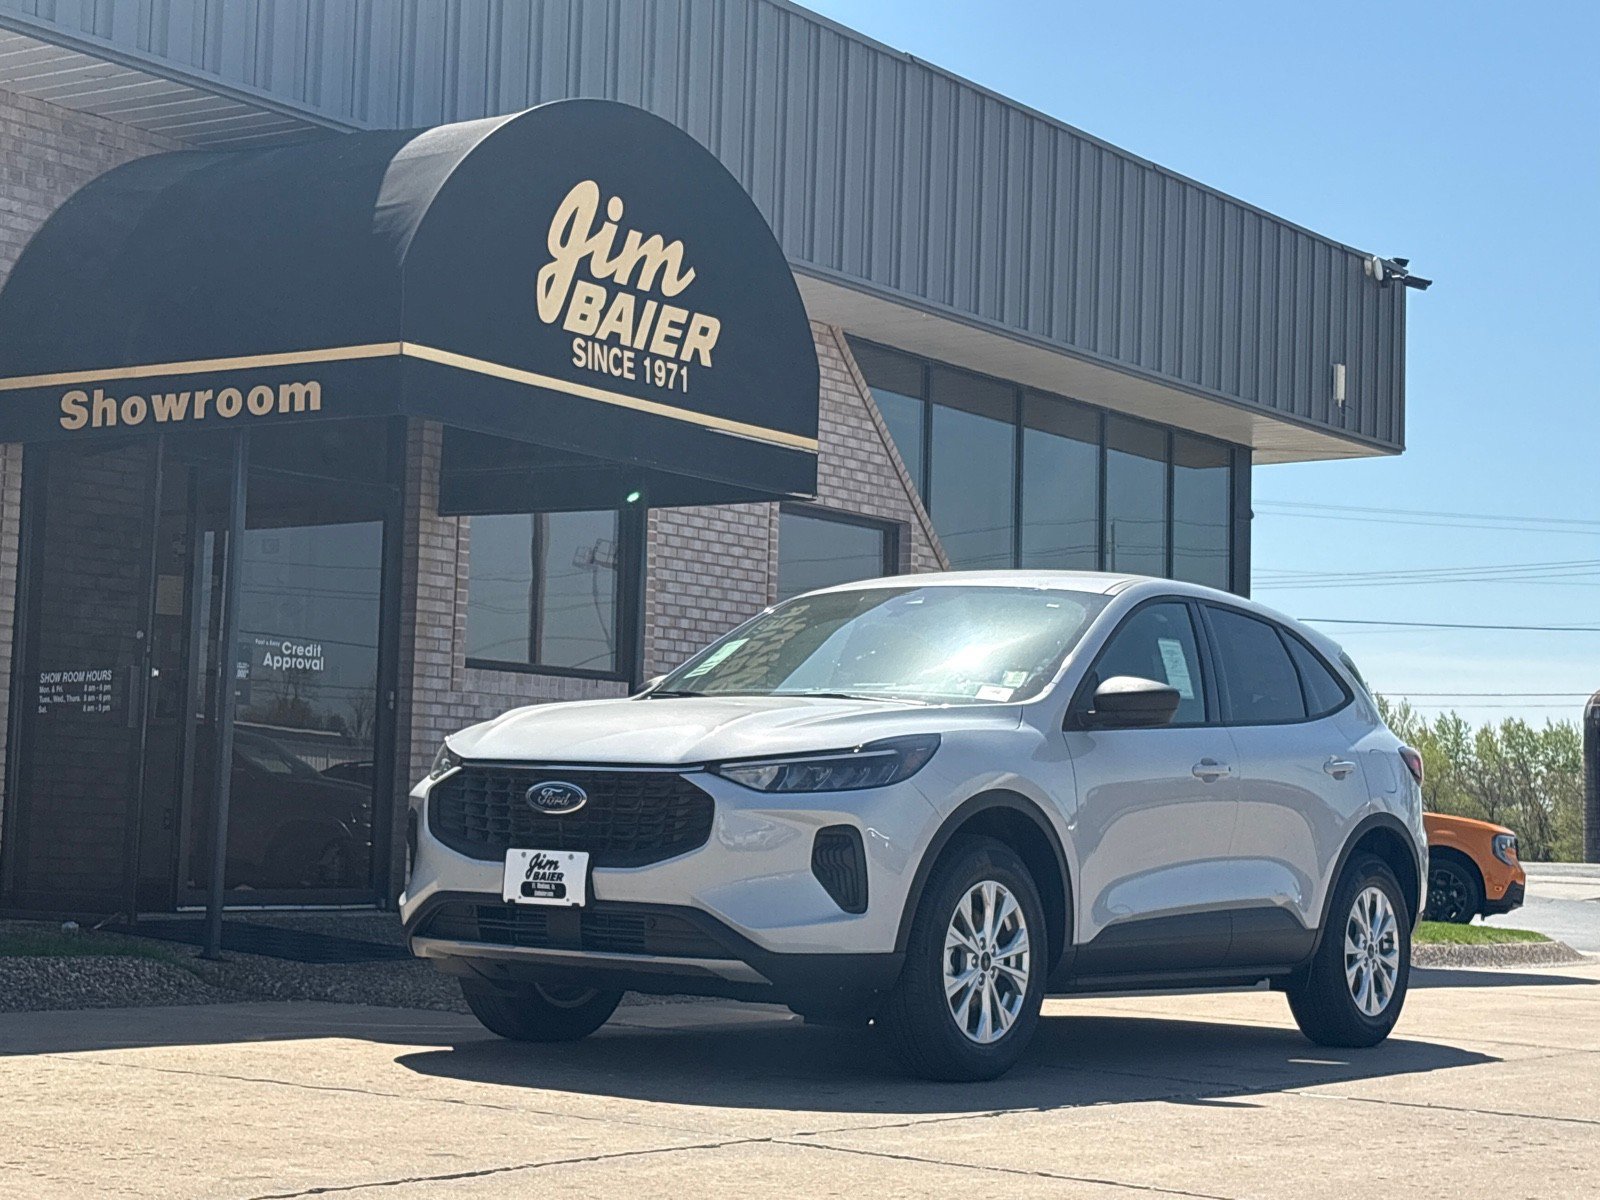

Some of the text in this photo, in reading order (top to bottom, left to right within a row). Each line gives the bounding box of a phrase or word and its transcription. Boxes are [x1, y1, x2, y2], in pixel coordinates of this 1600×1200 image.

[537, 180, 696, 323] Jim
[563, 280, 720, 367] BAIER
[572, 337, 688, 393] SINCE 1971
[60, 380, 321, 430] Showroom
[281, 641, 321, 657] Credit
[262, 652, 324, 671] Approval
[40, 669, 112, 683] SHOW ROOM HOURS
[538, 787, 571, 806] Ford
[525, 852, 560, 880] Jim
[532, 871, 565, 882] BAIER
